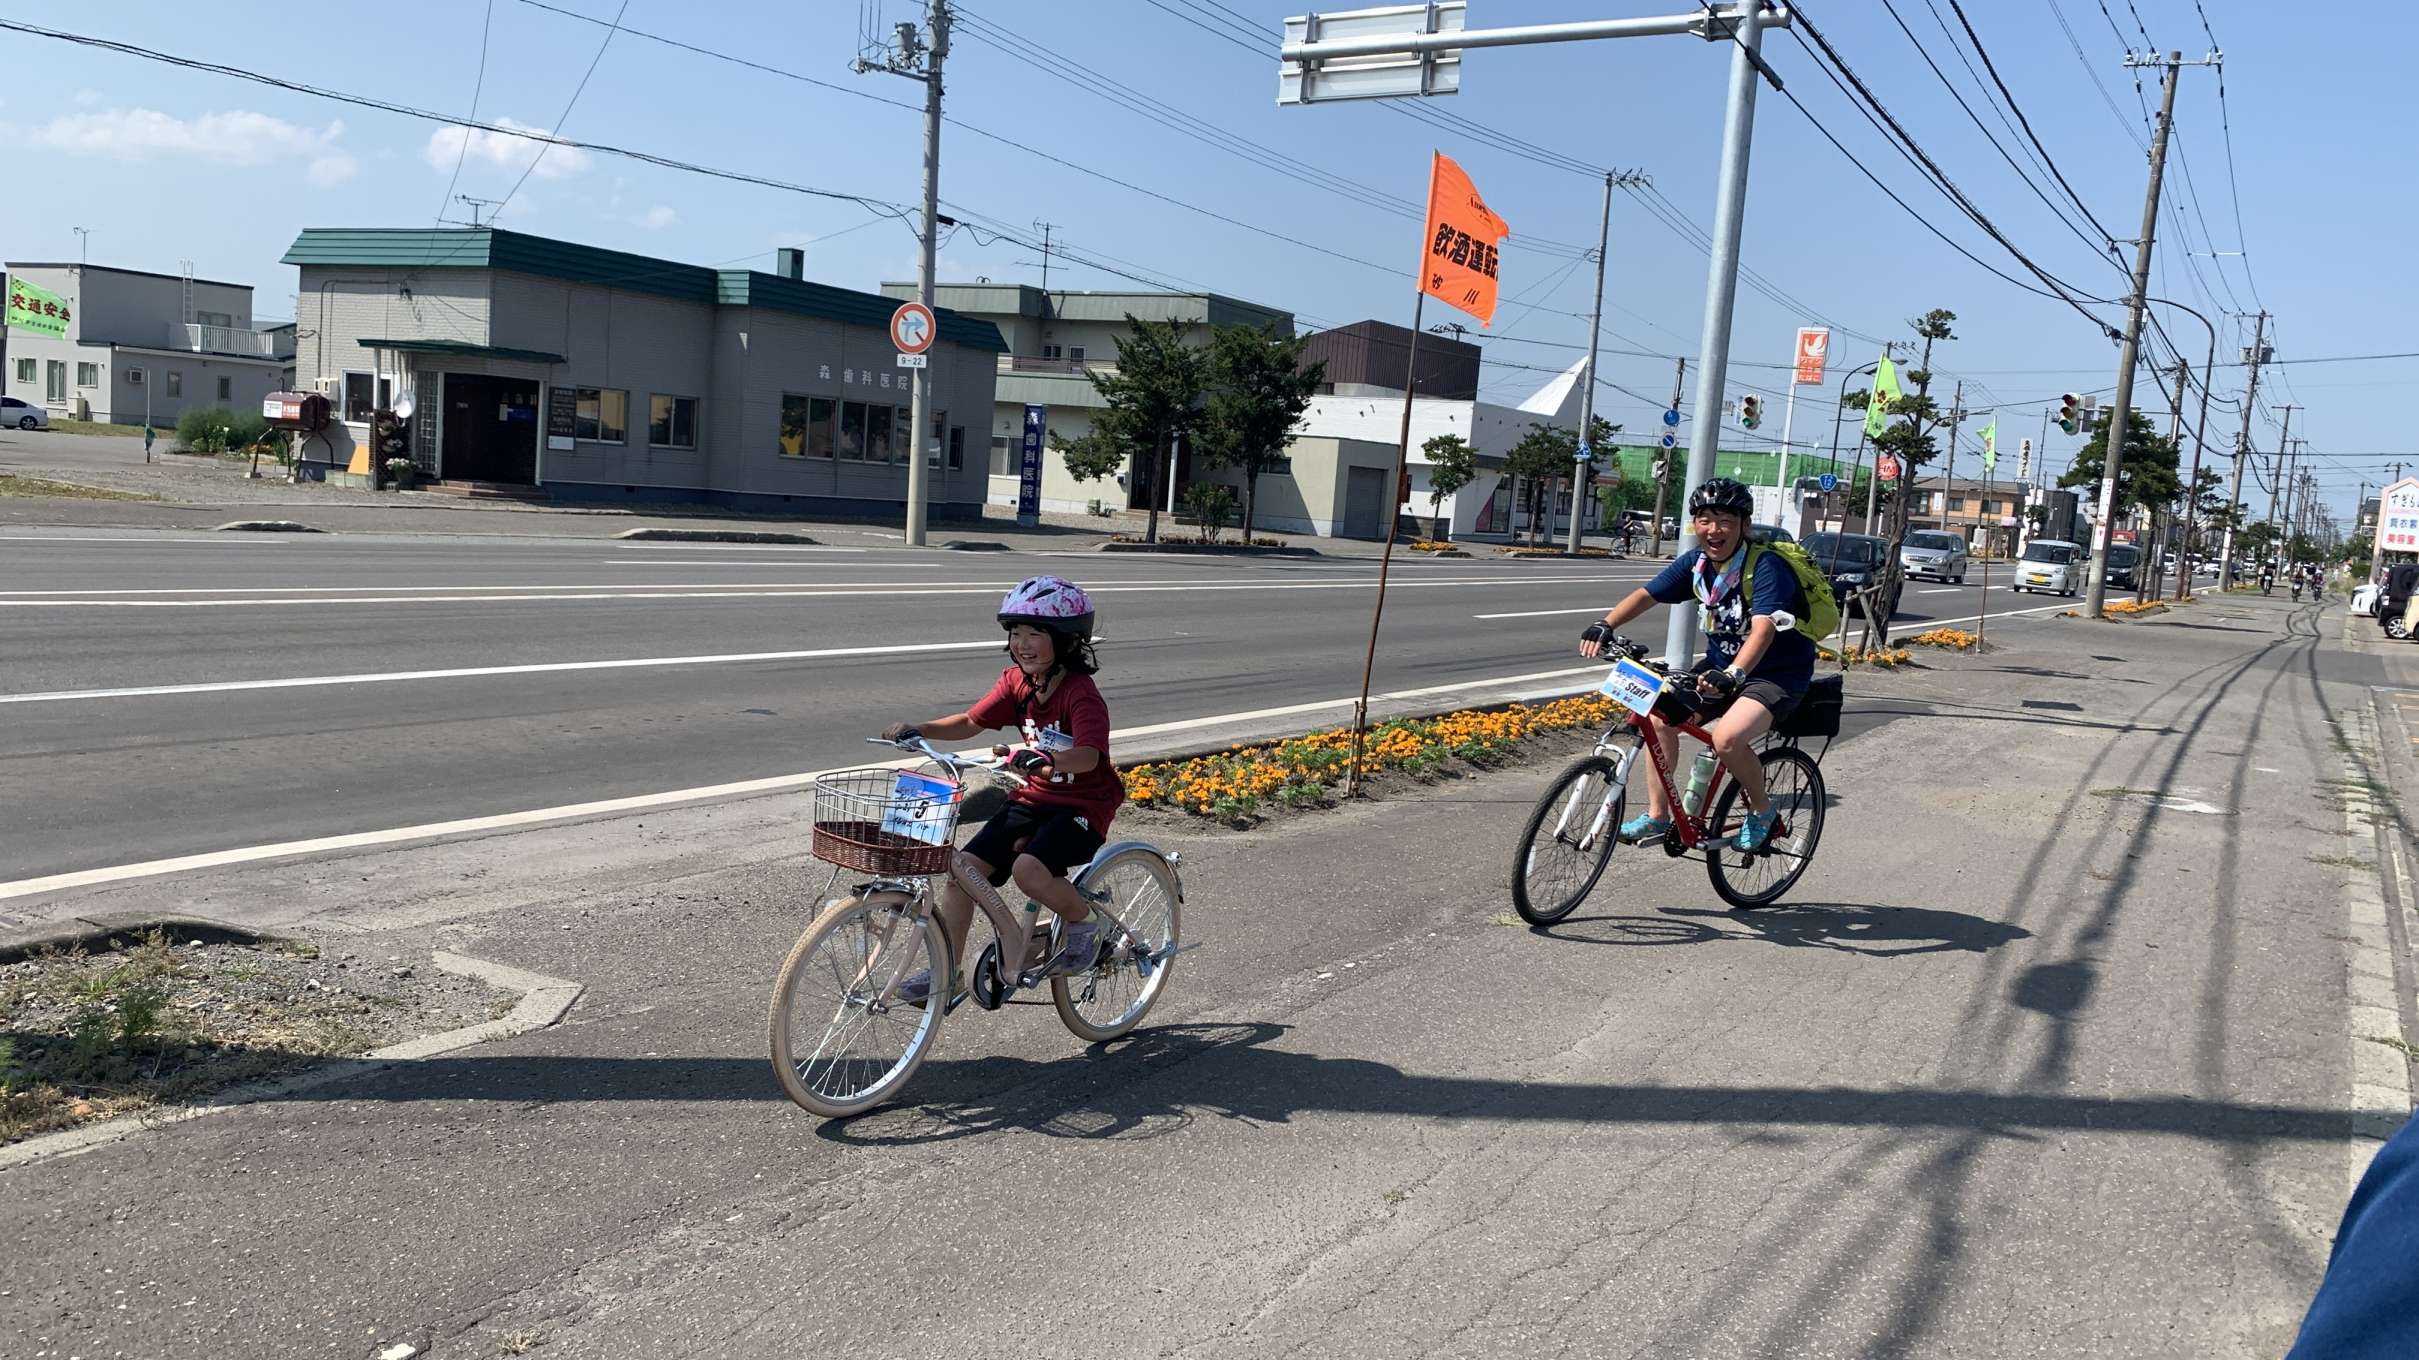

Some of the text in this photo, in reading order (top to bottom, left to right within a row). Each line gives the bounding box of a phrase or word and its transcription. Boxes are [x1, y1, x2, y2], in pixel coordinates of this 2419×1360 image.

[11, 293, 71, 322] 交通安全
[1625, 682, 1651, 699] Staff
[914, 801, 930, 819] 5
